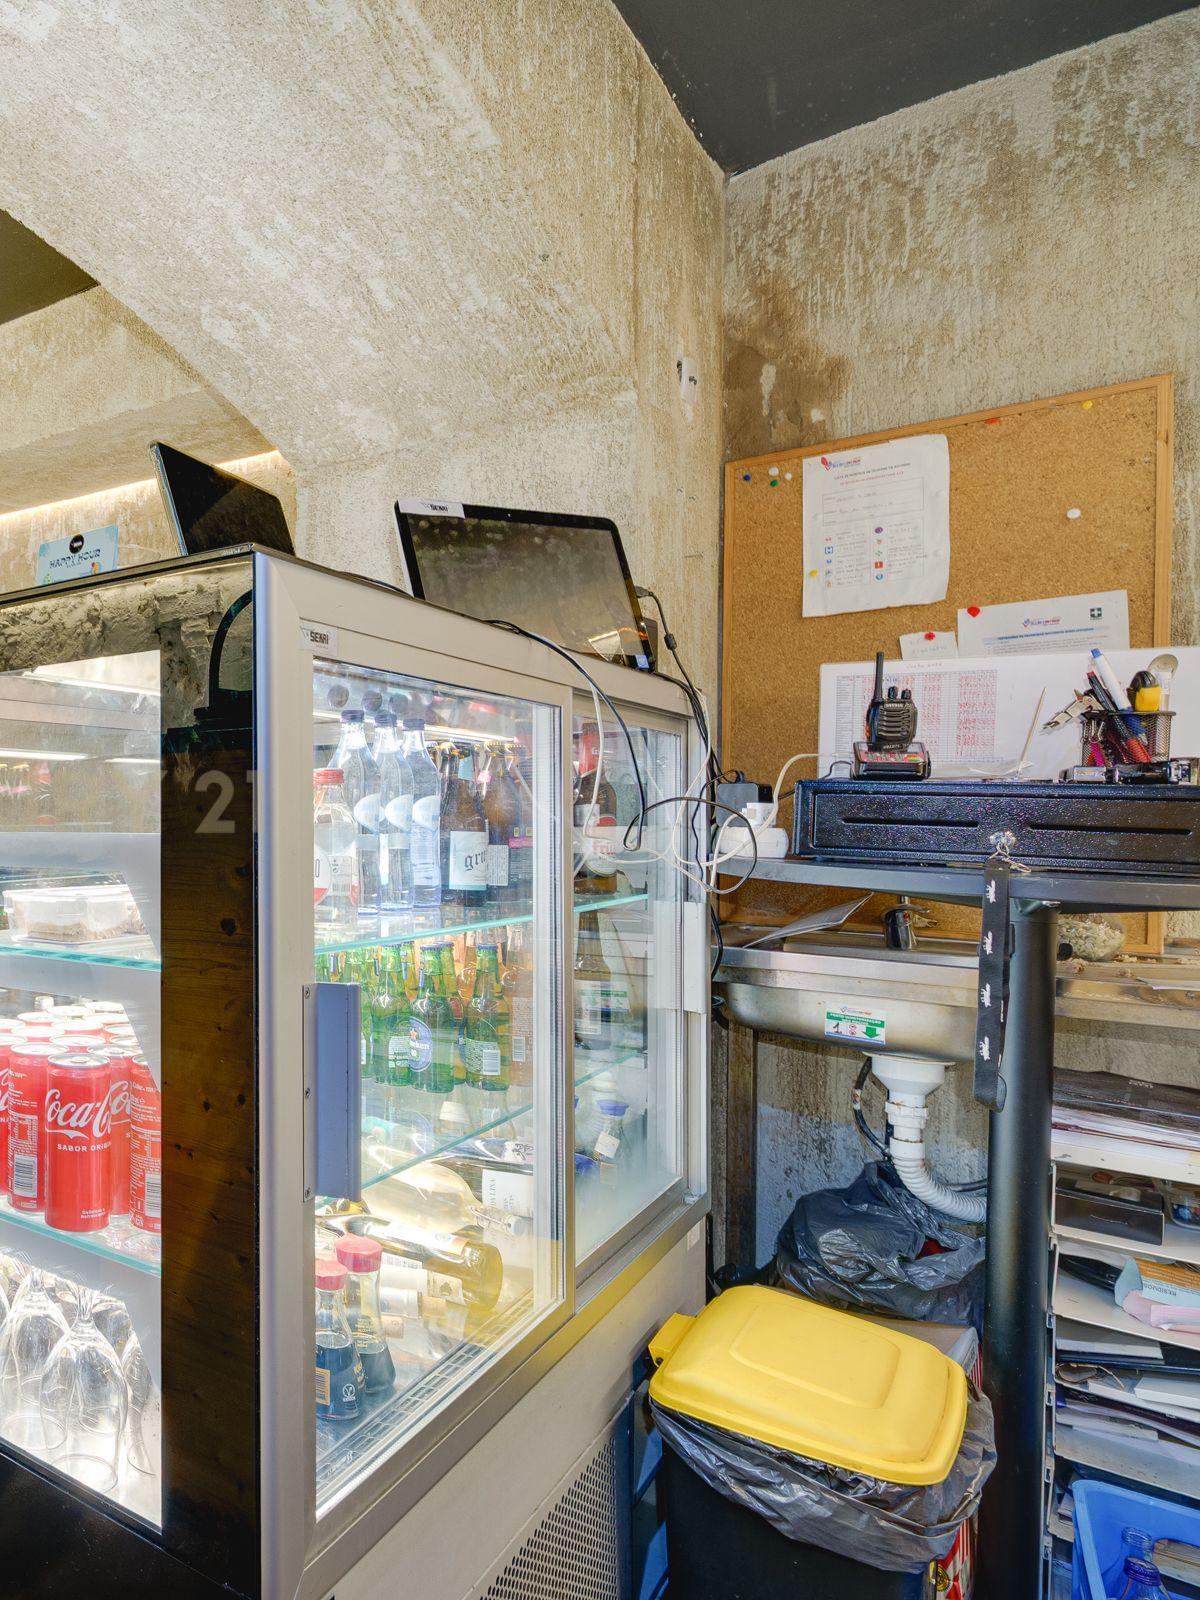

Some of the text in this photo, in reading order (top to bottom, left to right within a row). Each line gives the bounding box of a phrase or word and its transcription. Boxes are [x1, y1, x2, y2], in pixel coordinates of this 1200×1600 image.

[49, 555, 76, 569] HAPPY
[78, 548, 101, 562] HOUR
[57, 1143, 88, 1153] SABOR
